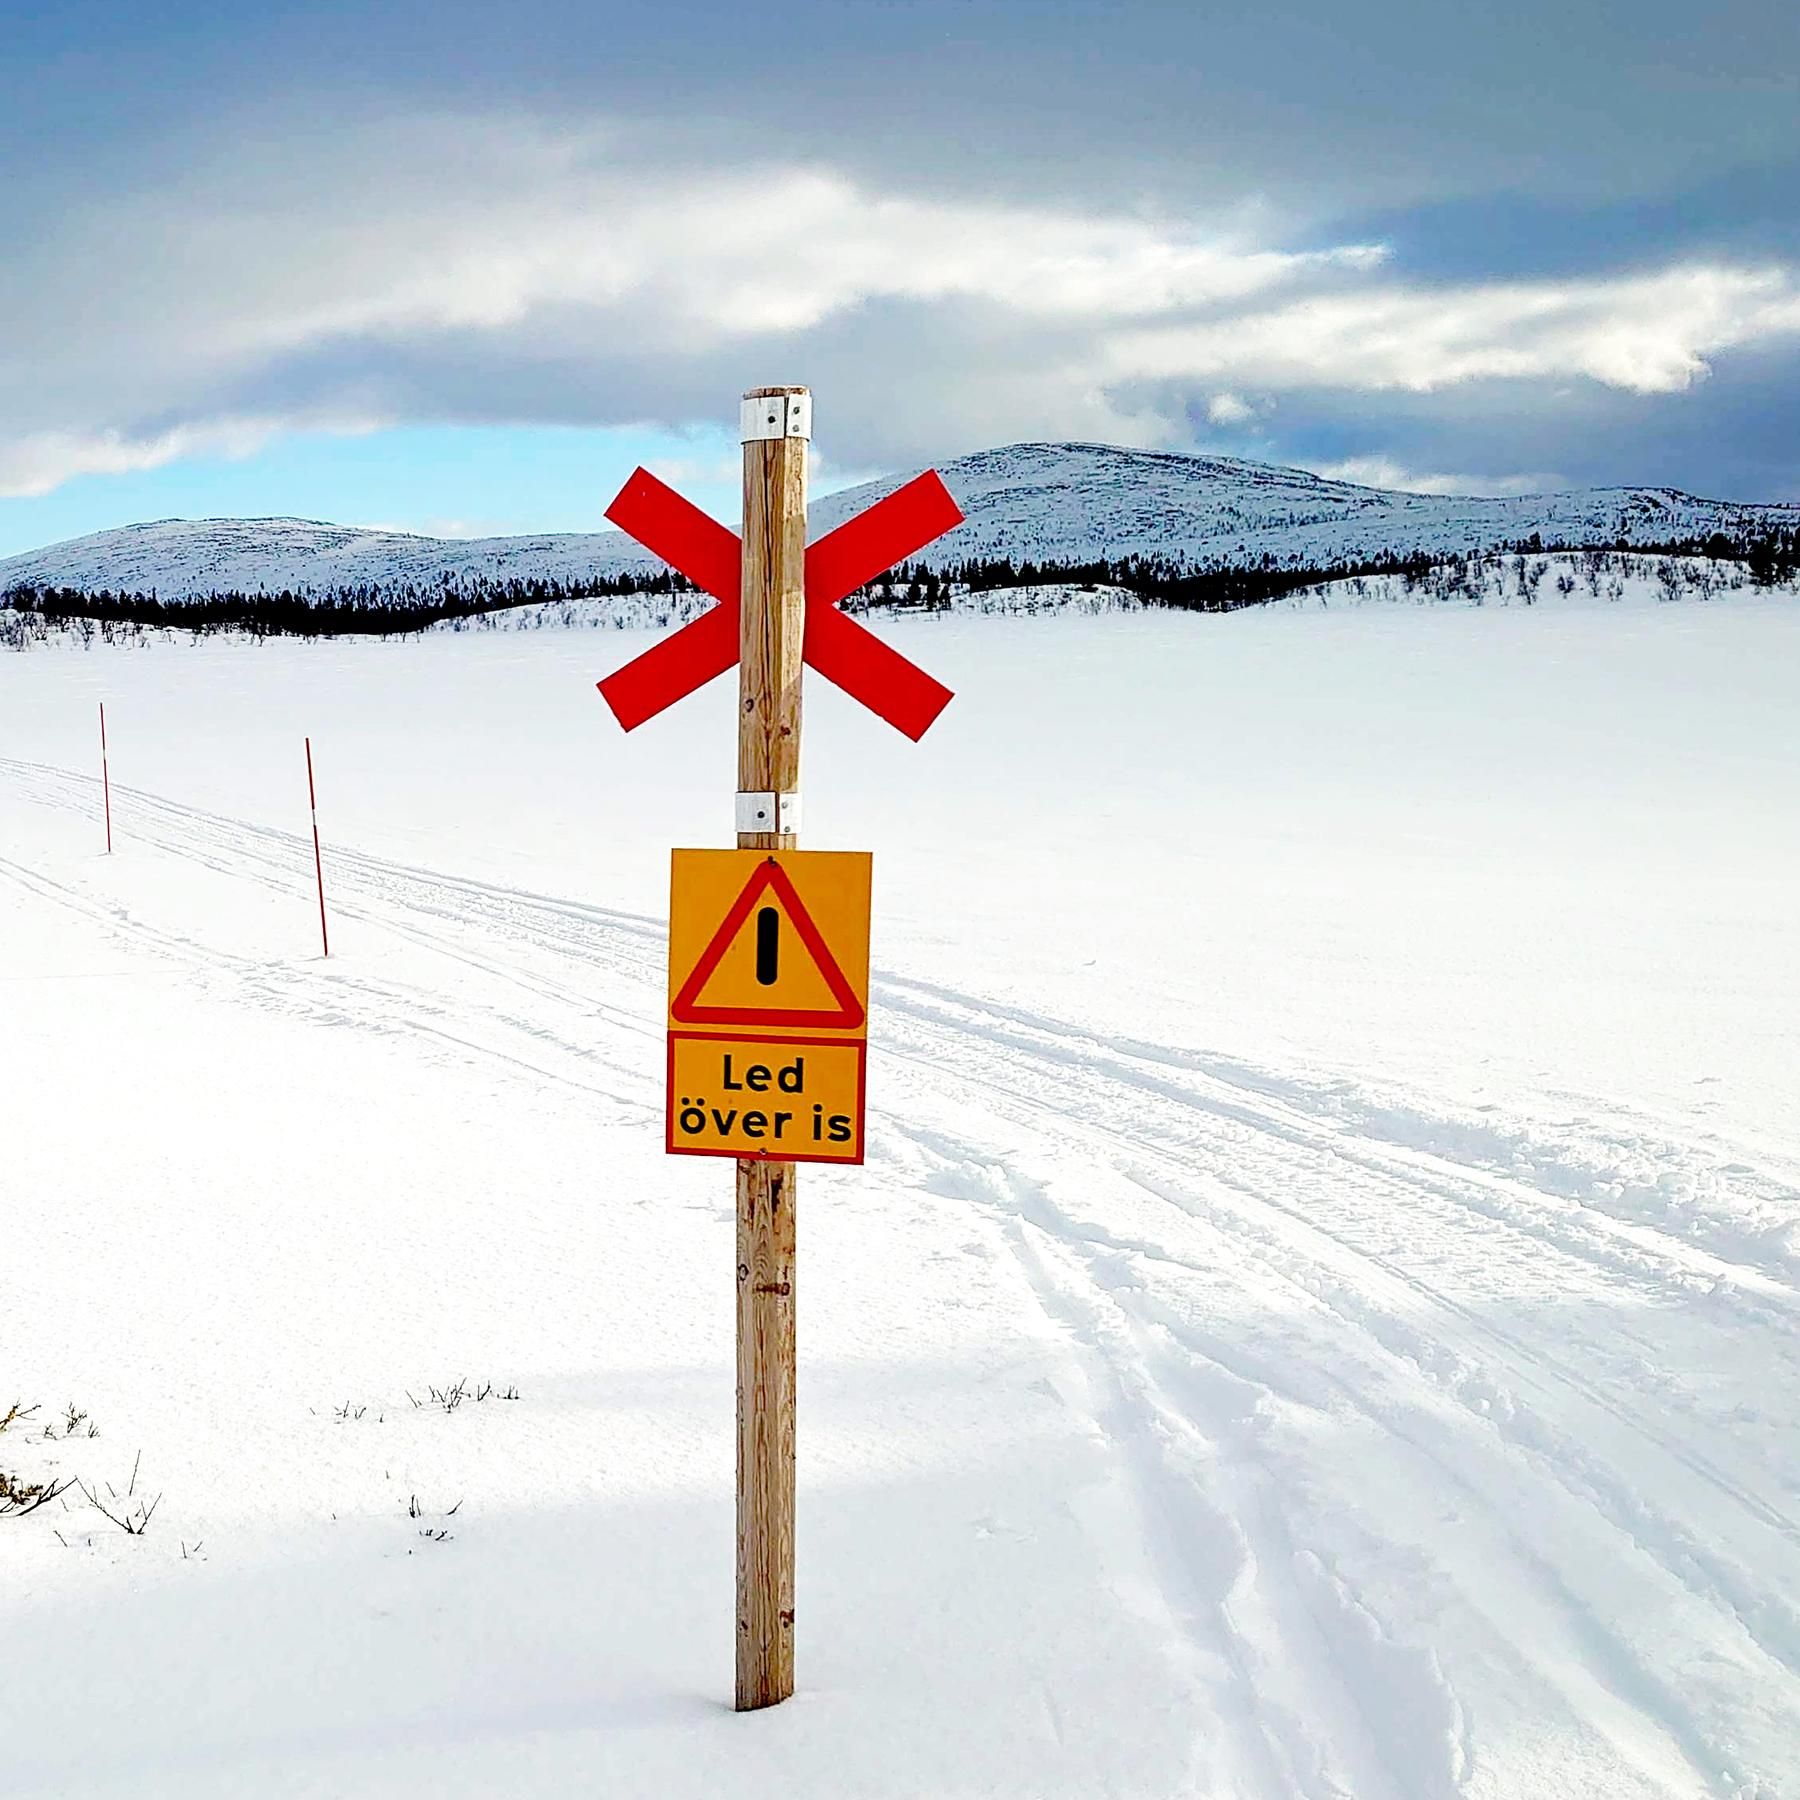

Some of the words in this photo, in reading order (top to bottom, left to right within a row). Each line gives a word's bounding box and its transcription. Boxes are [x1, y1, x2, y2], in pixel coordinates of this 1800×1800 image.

[723, 1054, 804, 1094] Led
[679, 1097, 793, 1139] över
[812, 1103, 852, 1142] is
